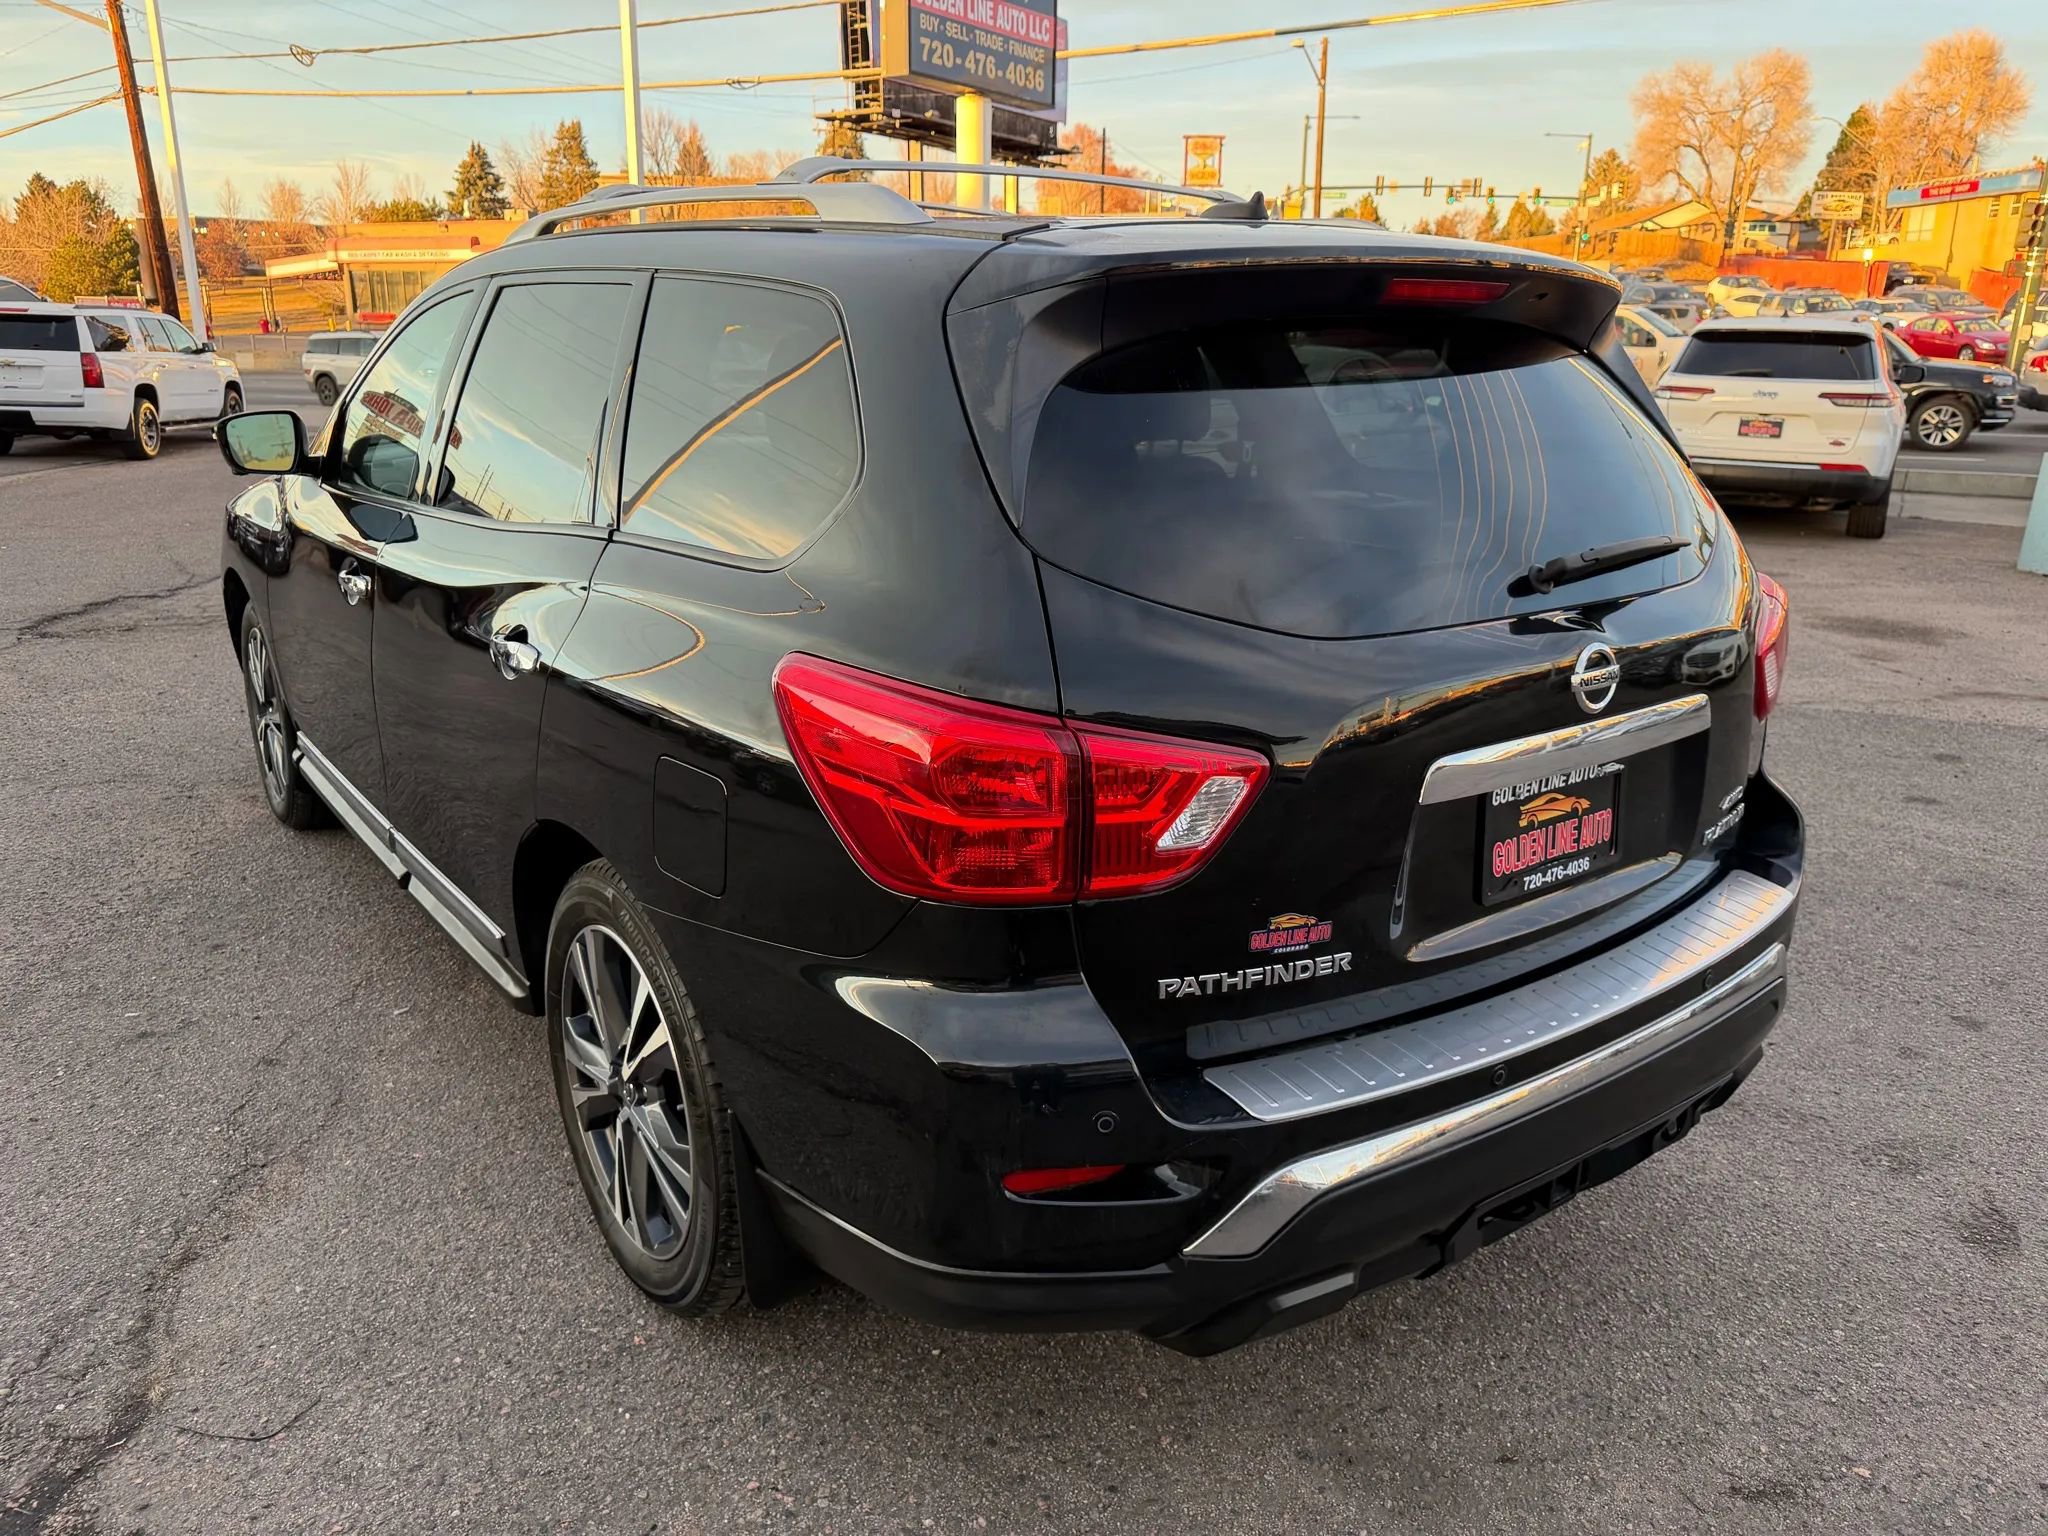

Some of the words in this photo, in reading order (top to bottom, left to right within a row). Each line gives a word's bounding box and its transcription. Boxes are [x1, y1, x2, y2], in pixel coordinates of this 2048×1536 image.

[920, 13, 940, 33] BUY
[945, 23, 970, 42] SELL
[974, 30, 1004, 52] TRADE
[1009, 40, 1045, 63] FINANCE
[968, 0, 995, 26] LINE
[996, 4, 1027, 36] AUTO
[1029, 15, 1050, 43] LLC
[1579, 669, 1618, 688] NISSAN
[1492, 780, 1540, 806] GOLDEN
[1541, 773, 1567, 792] LINE
[1493, 828, 1546, 878] GOLDEN
[1547, 818, 1578, 859] LINE
[1579, 808, 1612, 850] AUTO
[1523, 857, 1590, 891] 720-476-4036
[1251, 930, 1288, 950] GOLDEN
[1288, 927, 1308, 945] LINE
[1308, 924, 1332, 942] AUTO
[1157, 951, 1353, 1000] PATHFINDER
